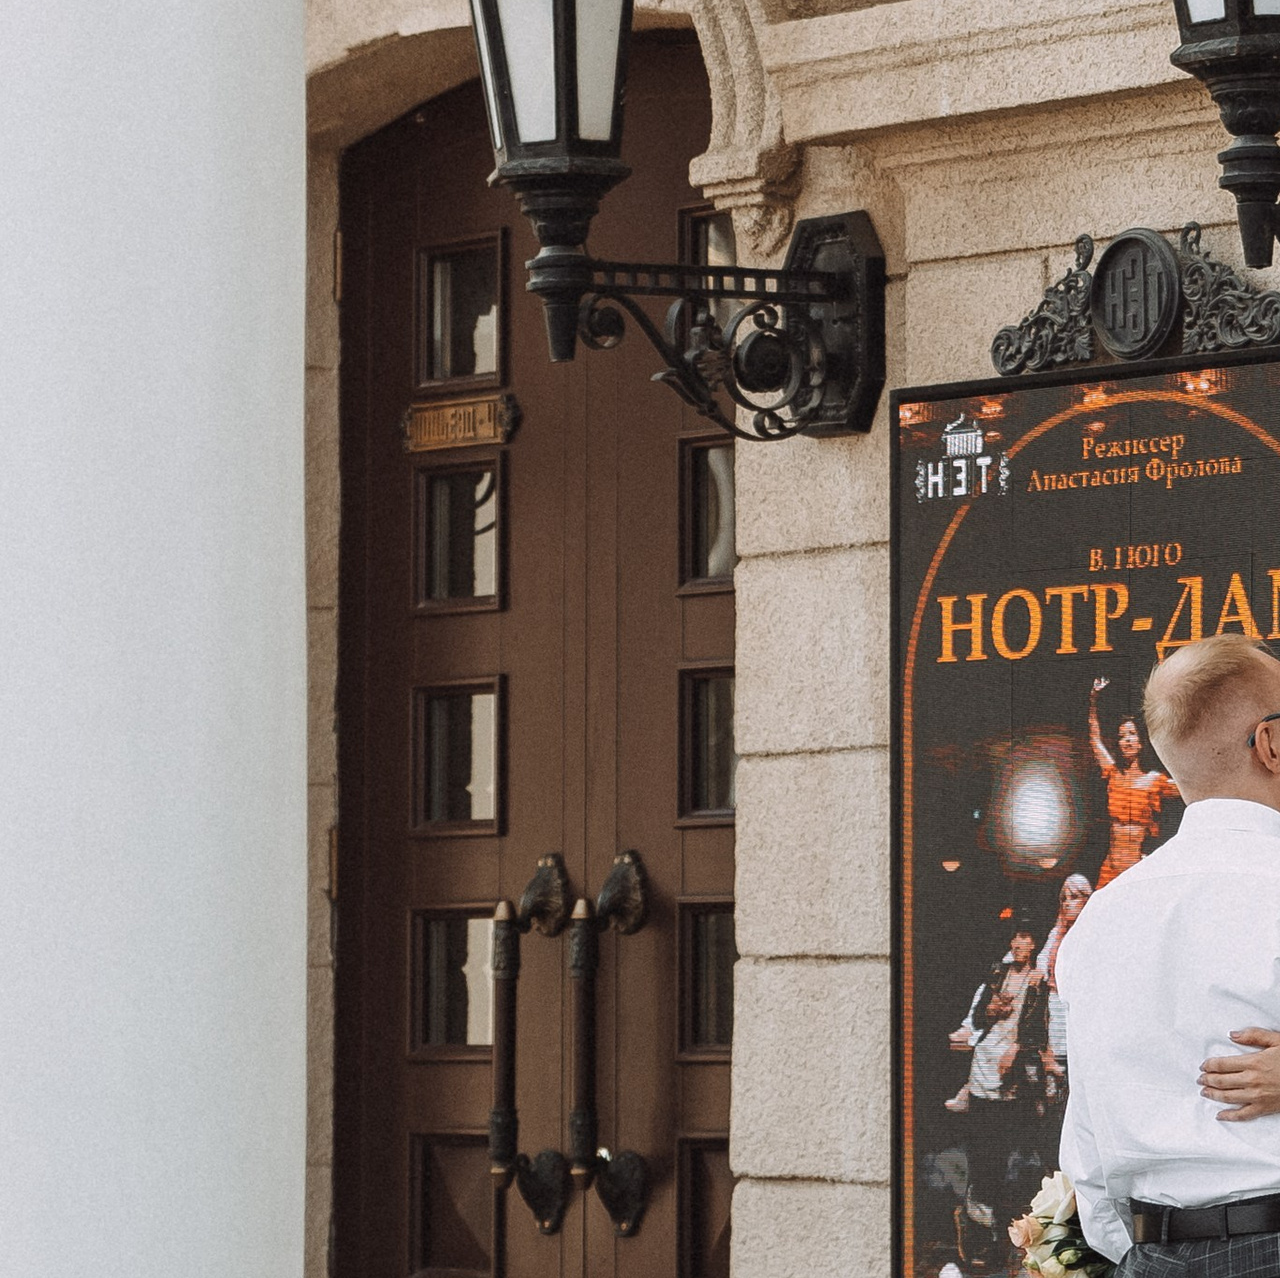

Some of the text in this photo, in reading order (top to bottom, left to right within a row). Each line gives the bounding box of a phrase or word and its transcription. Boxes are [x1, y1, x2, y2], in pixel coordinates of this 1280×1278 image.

[1104, 248, 1165, 343] НЭТ
[1082, 434, 1185, 460] Режиссер
[927, 455, 993, 499] НЭТ
